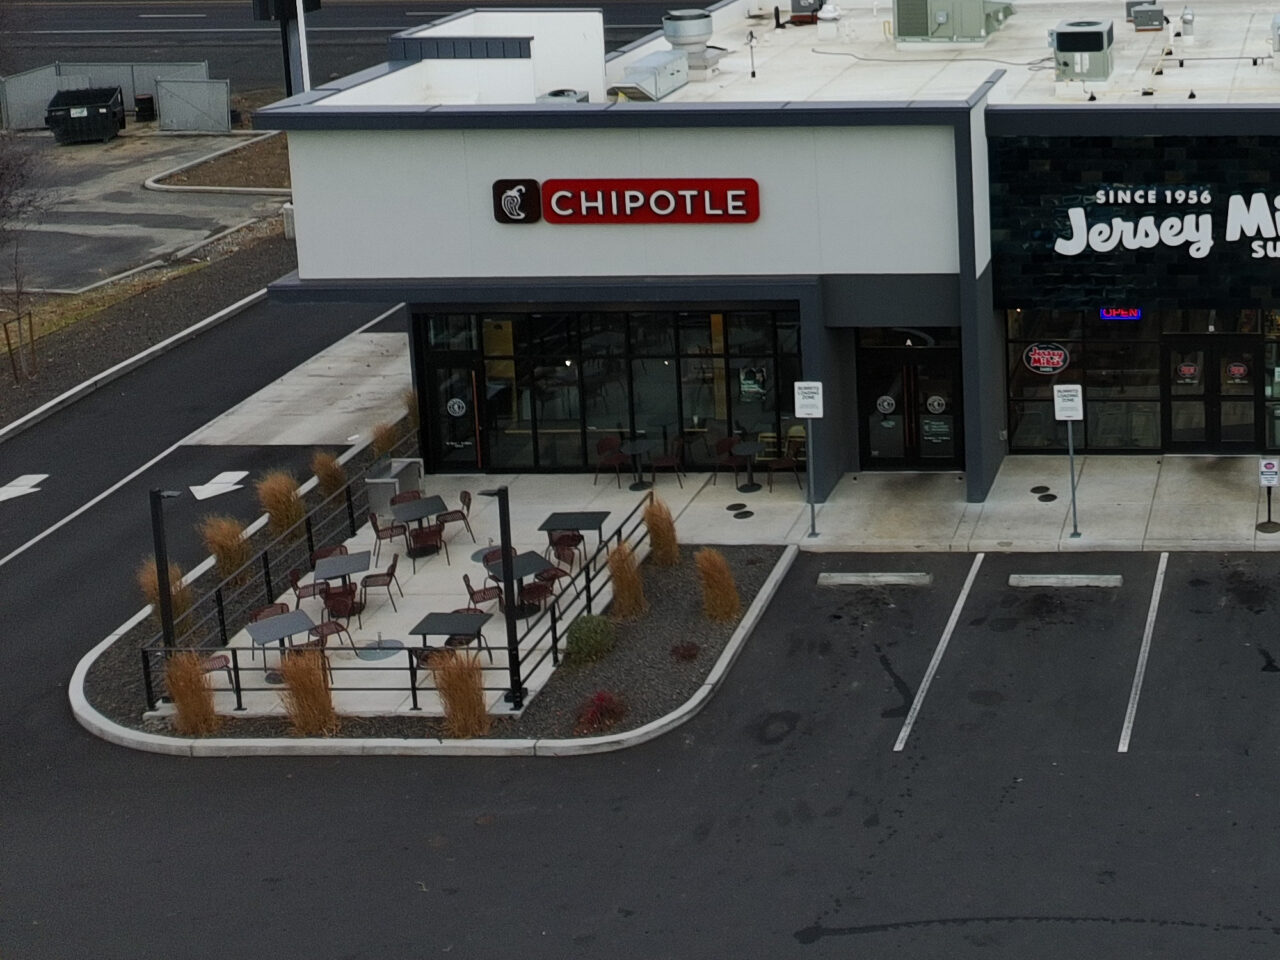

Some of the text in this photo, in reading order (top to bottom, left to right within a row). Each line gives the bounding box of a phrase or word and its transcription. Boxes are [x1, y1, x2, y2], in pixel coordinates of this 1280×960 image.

[551, 190, 747, 216] CHIPOTLE
[1096, 190, 1212, 204] SINCE 1956
[1054, 207, 1214, 258] Jersey
[1103, 308, 1138, 317] OPEN
